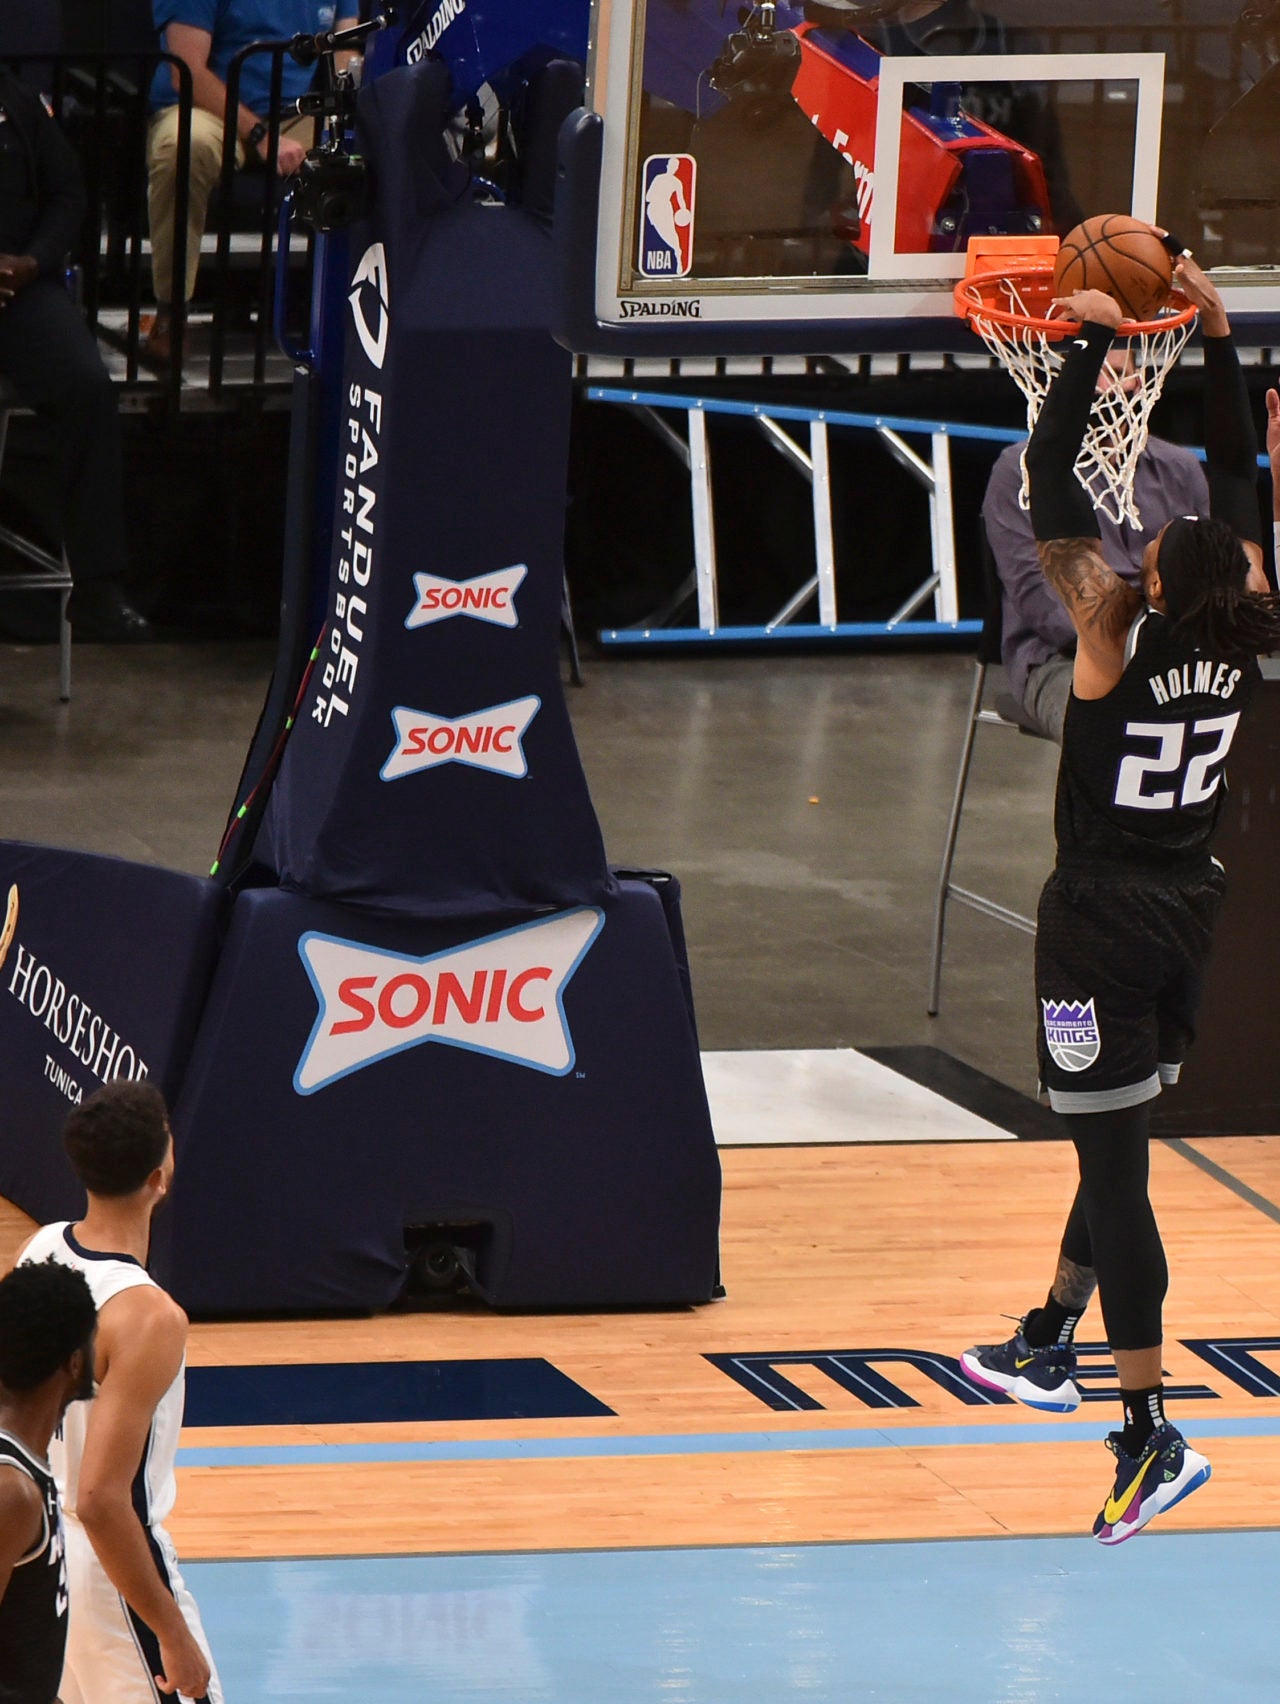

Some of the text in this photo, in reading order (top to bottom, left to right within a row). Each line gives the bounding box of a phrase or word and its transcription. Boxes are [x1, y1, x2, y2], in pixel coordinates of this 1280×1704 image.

[646, 250, 672, 270] NBA
[619, 299, 702, 319] SPALDING
[312, 383, 361, 725] SPORTSBOOK
[323, 388, 382, 729] FANDUEL
[420, 587, 509, 610] SONIC
[1148, 660, 1242, 706] HOLMES
[401, 725, 516, 755] SONIC
[1114, 710, 1242, 811] 22
[329, 966, 553, 1037] SONIC
[1046, 1020, 1093, 1028] SACRAMENTO
[1048, 1028, 1098, 1043] KINGS
[43, 1054, 83, 1105] TUNICA
